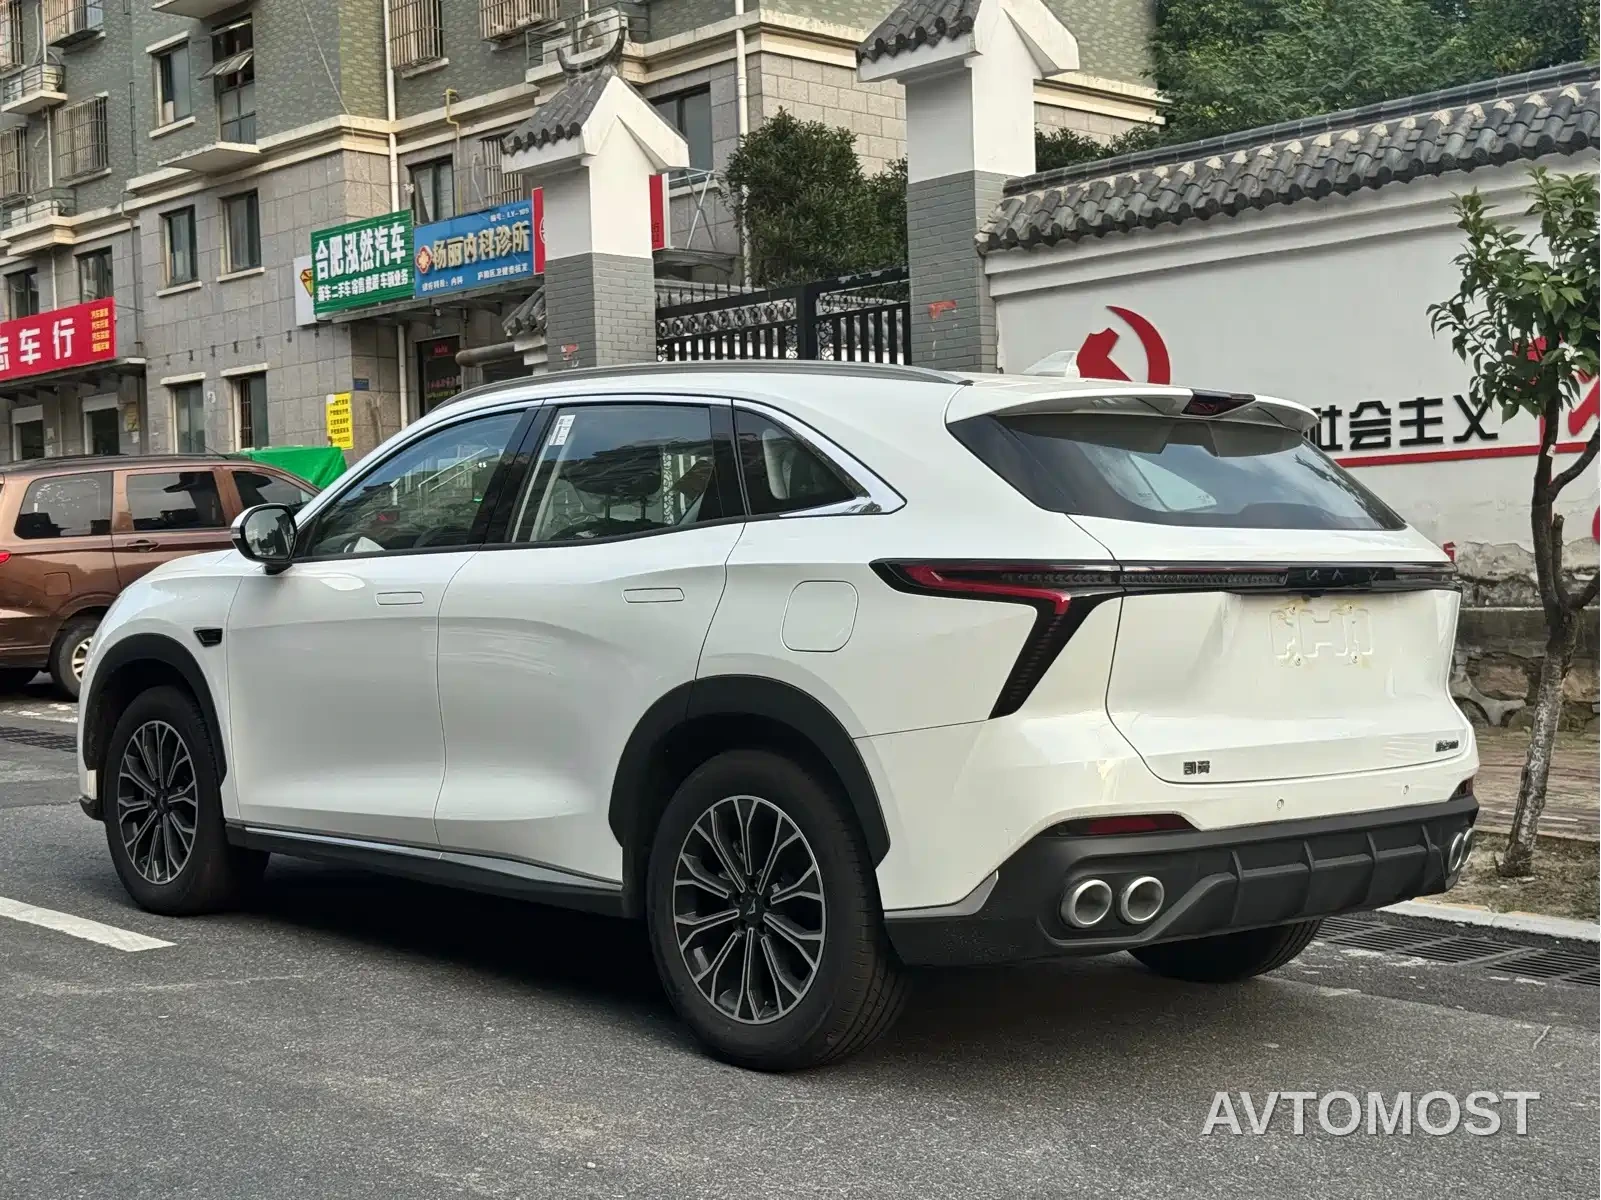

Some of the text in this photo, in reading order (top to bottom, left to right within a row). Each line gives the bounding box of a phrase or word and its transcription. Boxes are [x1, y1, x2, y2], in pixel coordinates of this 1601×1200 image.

[315, 222, 406, 281] 合肥泓然汽车
[431, 220, 530, 271] 杨丽内科诊所
